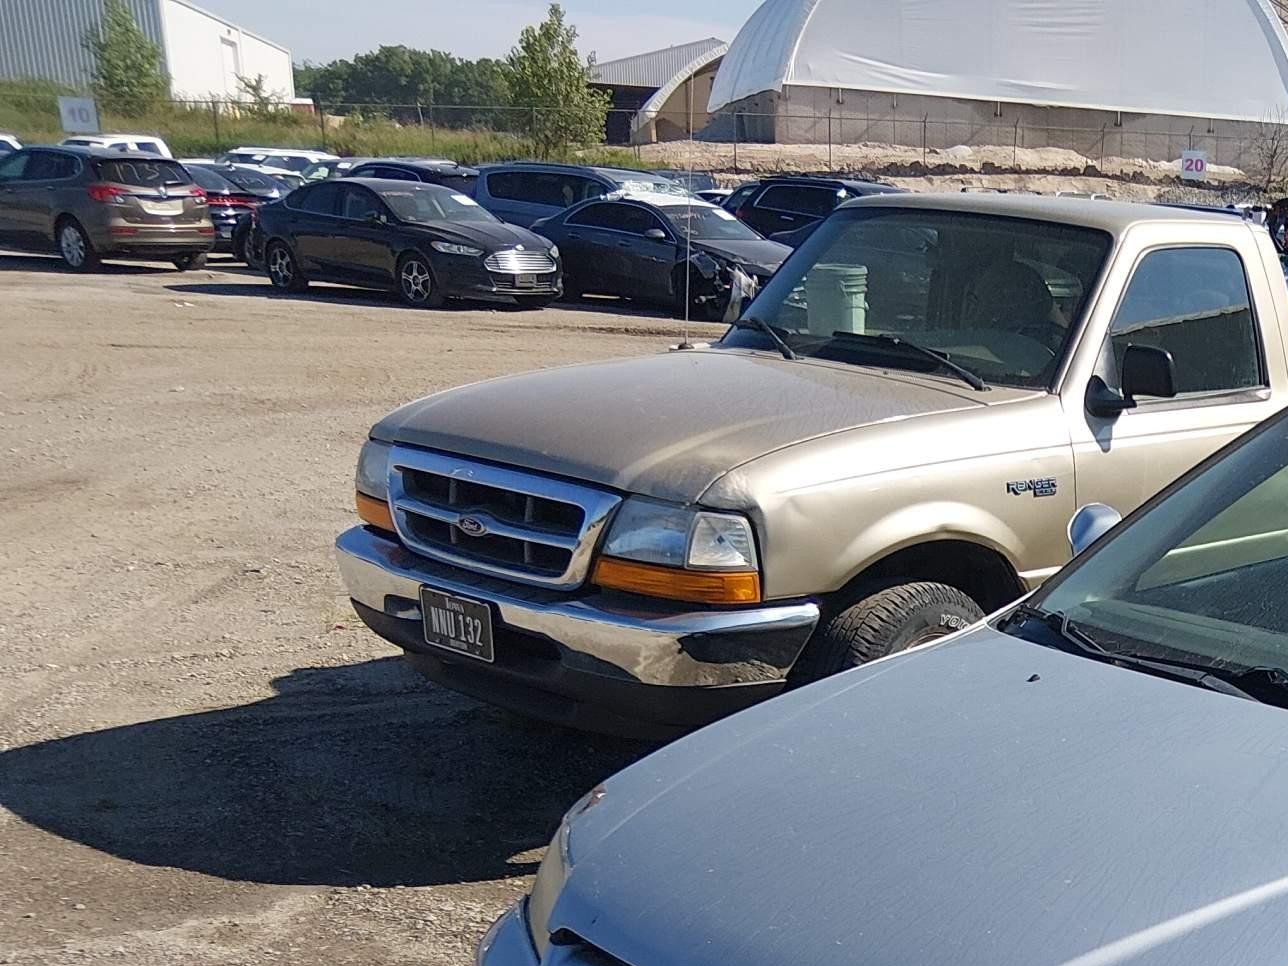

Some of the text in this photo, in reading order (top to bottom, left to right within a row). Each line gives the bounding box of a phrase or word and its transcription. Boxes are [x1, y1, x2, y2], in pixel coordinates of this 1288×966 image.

[1185, 158, 1204, 172] 20
[1006, 479, 1057, 495] RANGER
[459, 614, 483, 647] 132
